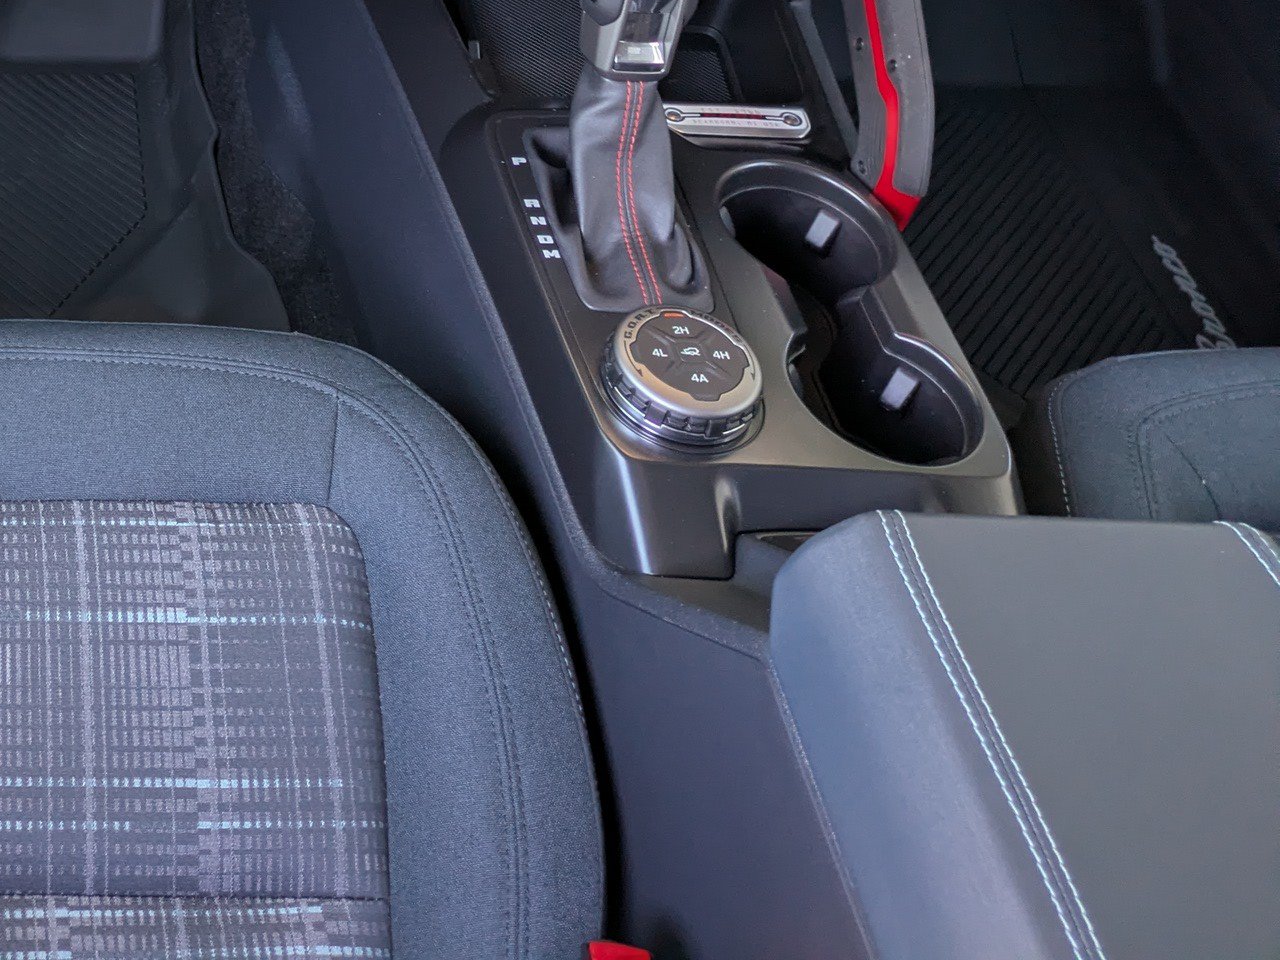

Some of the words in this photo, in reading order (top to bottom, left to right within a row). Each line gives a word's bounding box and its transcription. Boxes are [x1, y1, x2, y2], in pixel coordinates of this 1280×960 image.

[511, 157, 527, 166] P
[530, 217, 547, 225] N
[536, 235, 554, 244] D
[542, 250, 561, 258] M
[672, 326, 690, 335] 2H
[652, 348, 668, 357] 4L
[713, 351, 731, 360] 4H
[691, 373, 709, 383] 4A
